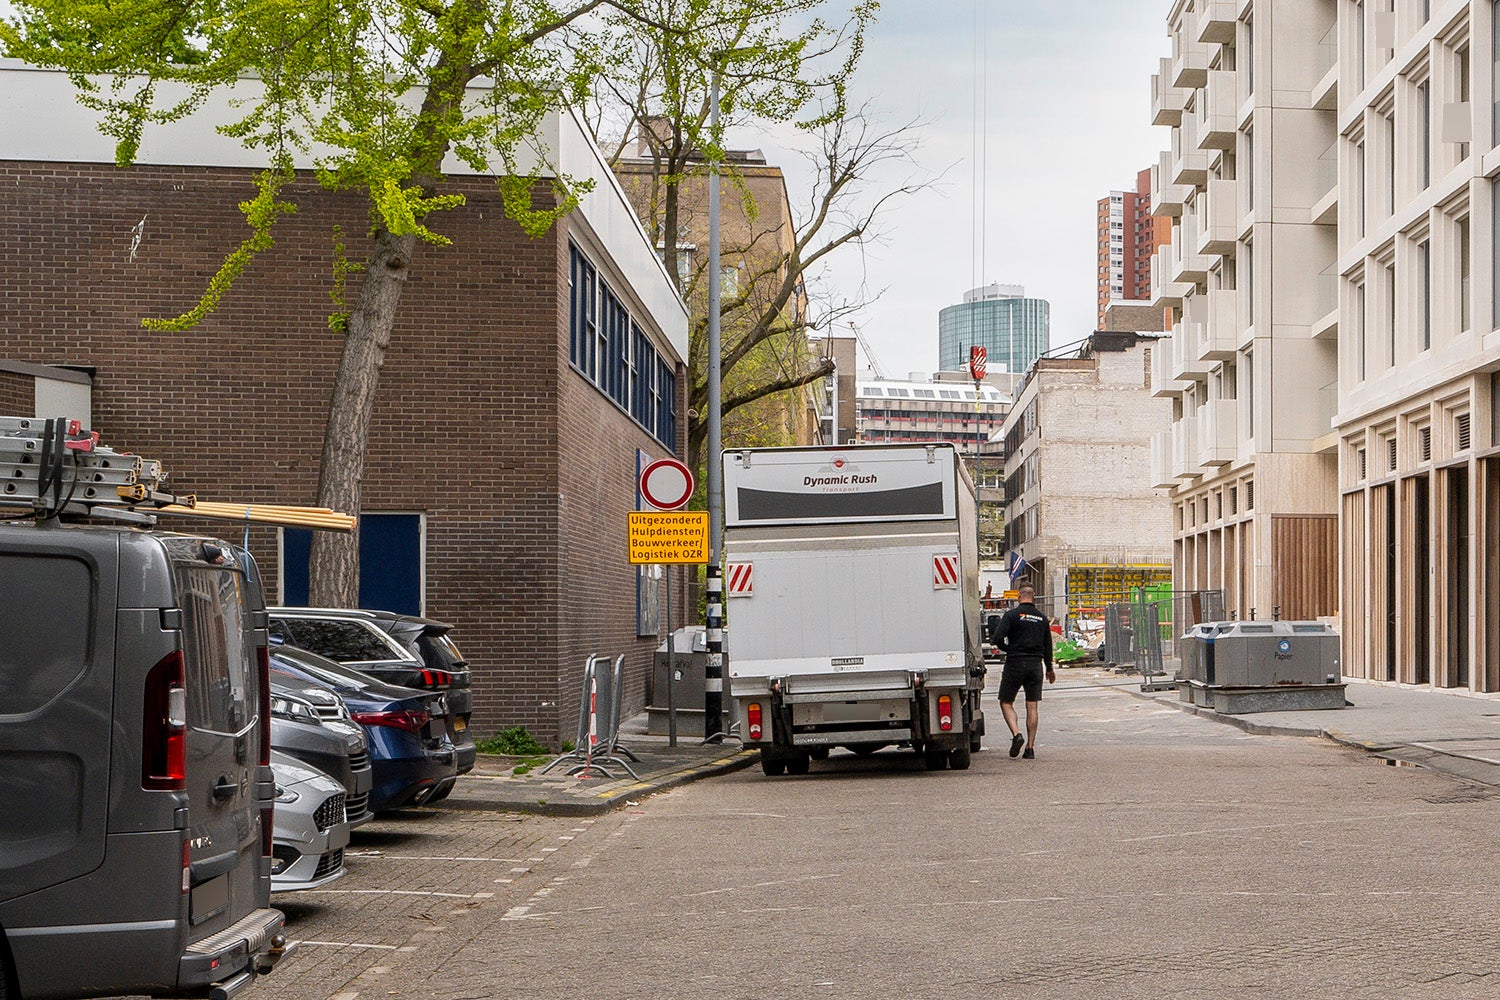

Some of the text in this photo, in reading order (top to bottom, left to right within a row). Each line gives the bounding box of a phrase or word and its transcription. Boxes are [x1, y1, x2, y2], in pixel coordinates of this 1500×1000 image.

[803, 474, 877, 487] Dynamic Rush
[631, 516, 702, 526] Uitgezonderd
[632, 527, 705, 537] Hulpdiensten/
[632, 538, 703, 549] Bouwverkeer/
[632, 550, 703, 560] Logistiek OZR
[1274, 651, 1293, 662] Papier
